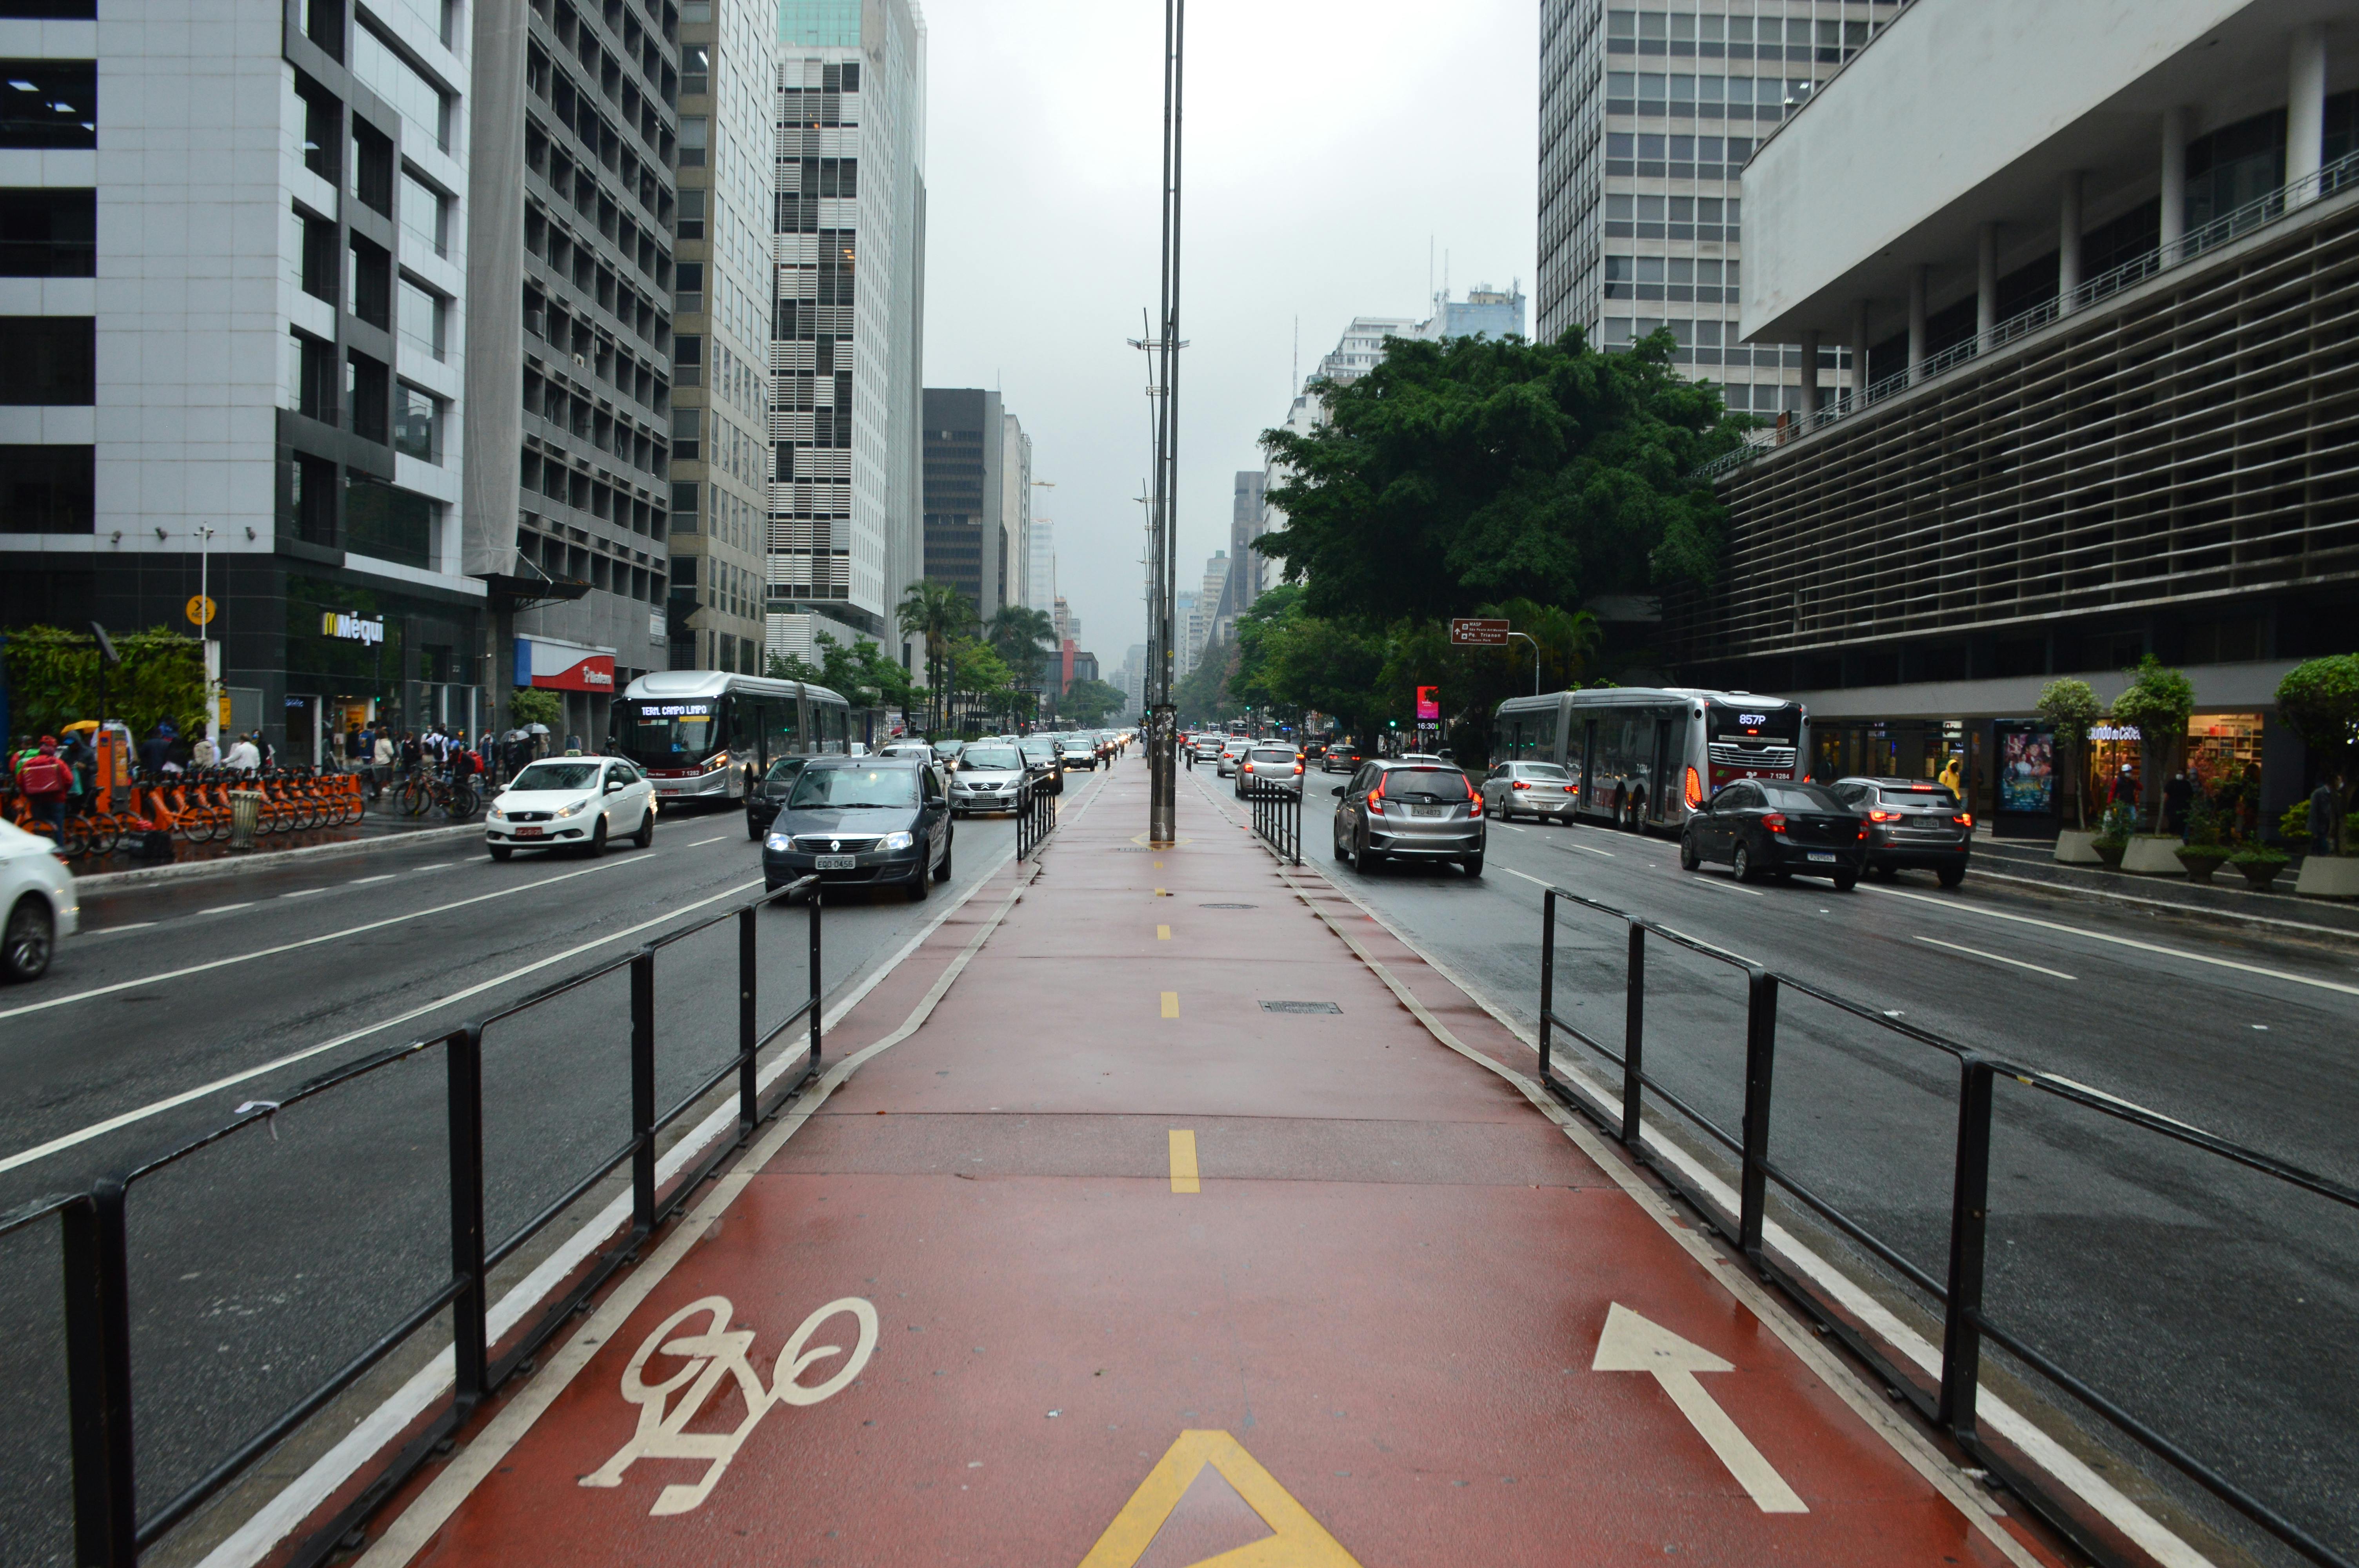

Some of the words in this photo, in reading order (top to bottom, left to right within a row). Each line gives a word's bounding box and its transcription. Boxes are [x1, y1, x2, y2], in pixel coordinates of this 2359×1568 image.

[337, 611, 383, 646] Méqui
[662, 706, 685, 715] CAMPO
[686, 705, 707, 715] LIMPO
[1739, 714, 1766, 725] 857P
